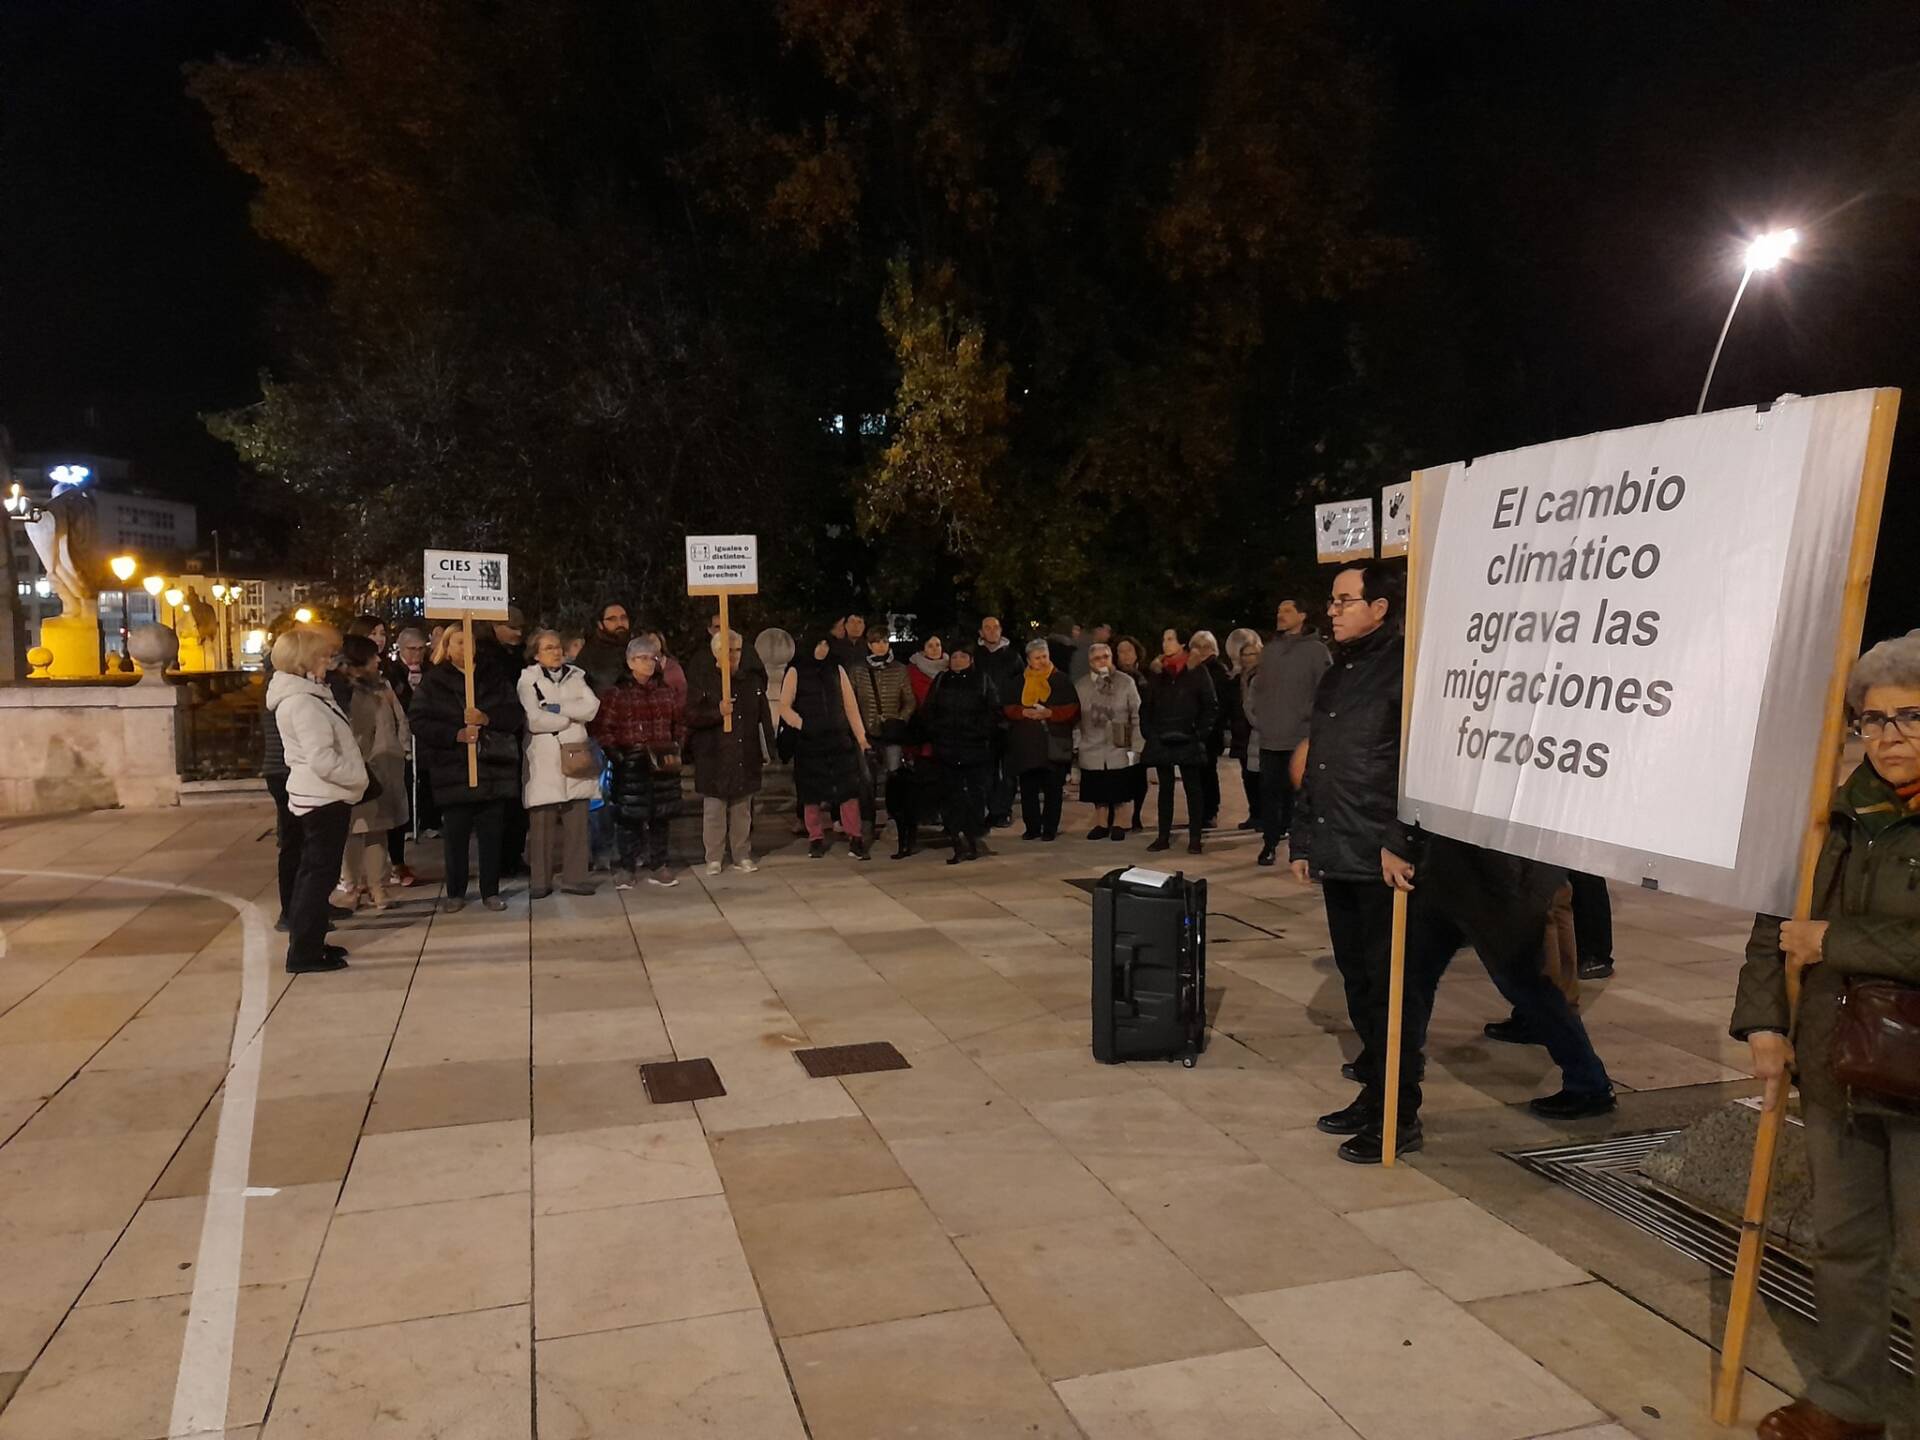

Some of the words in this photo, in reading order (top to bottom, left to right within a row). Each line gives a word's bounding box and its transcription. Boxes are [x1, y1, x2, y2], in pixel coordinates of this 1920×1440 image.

[1492, 486, 1528, 529] El
[1535, 466, 1686, 524] cambio
[439, 559, 471, 571] CIES
[1487, 535, 1660, 585] climático
[1466, 610, 1581, 653] agrava
[1592, 599, 1661, 646] las
[1443, 659, 1673, 717] migraciones
[1457, 716, 1610, 778] forzosas
